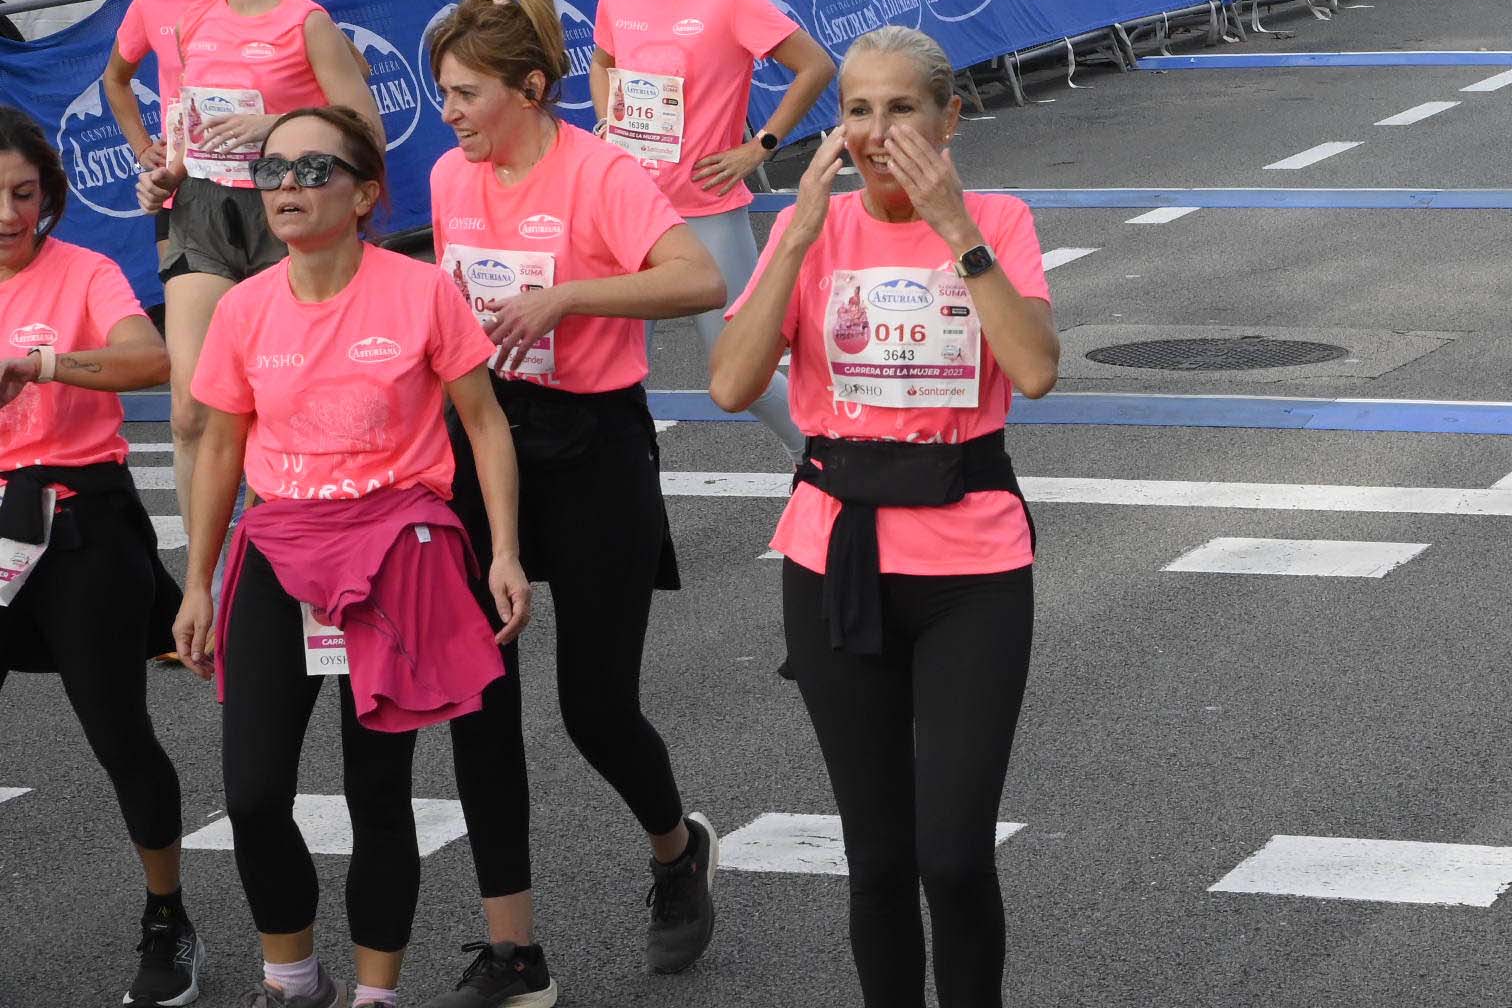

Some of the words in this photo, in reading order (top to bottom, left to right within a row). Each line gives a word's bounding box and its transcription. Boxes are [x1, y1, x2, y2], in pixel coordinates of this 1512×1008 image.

[369, 60, 401, 76] ECHERA
[626, 104, 654, 120] 016
[628, 121, 650, 131] 16398
[80, 126, 122, 143] CENTRAL
[470, 269, 513, 282] ASTURIANA
[519, 267, 544, 277] SUMA
[871, 290, 931, 304] ASTURIANA
[874, 322, 927, 343] 016
[508, 354, 544, 365] Sander
[882, 348, 916, 361] 3643
[843, 366, 882, 377] CARRERA
[883, 368, 896, 377] DE
[896, 368, 909, 377] LA
[909, 368, 941, 377] MUJER
[942, 368, 965, 377] 2023
[917, 386, 967, 397] Santander
[321, 637, 347, 647] CARR
